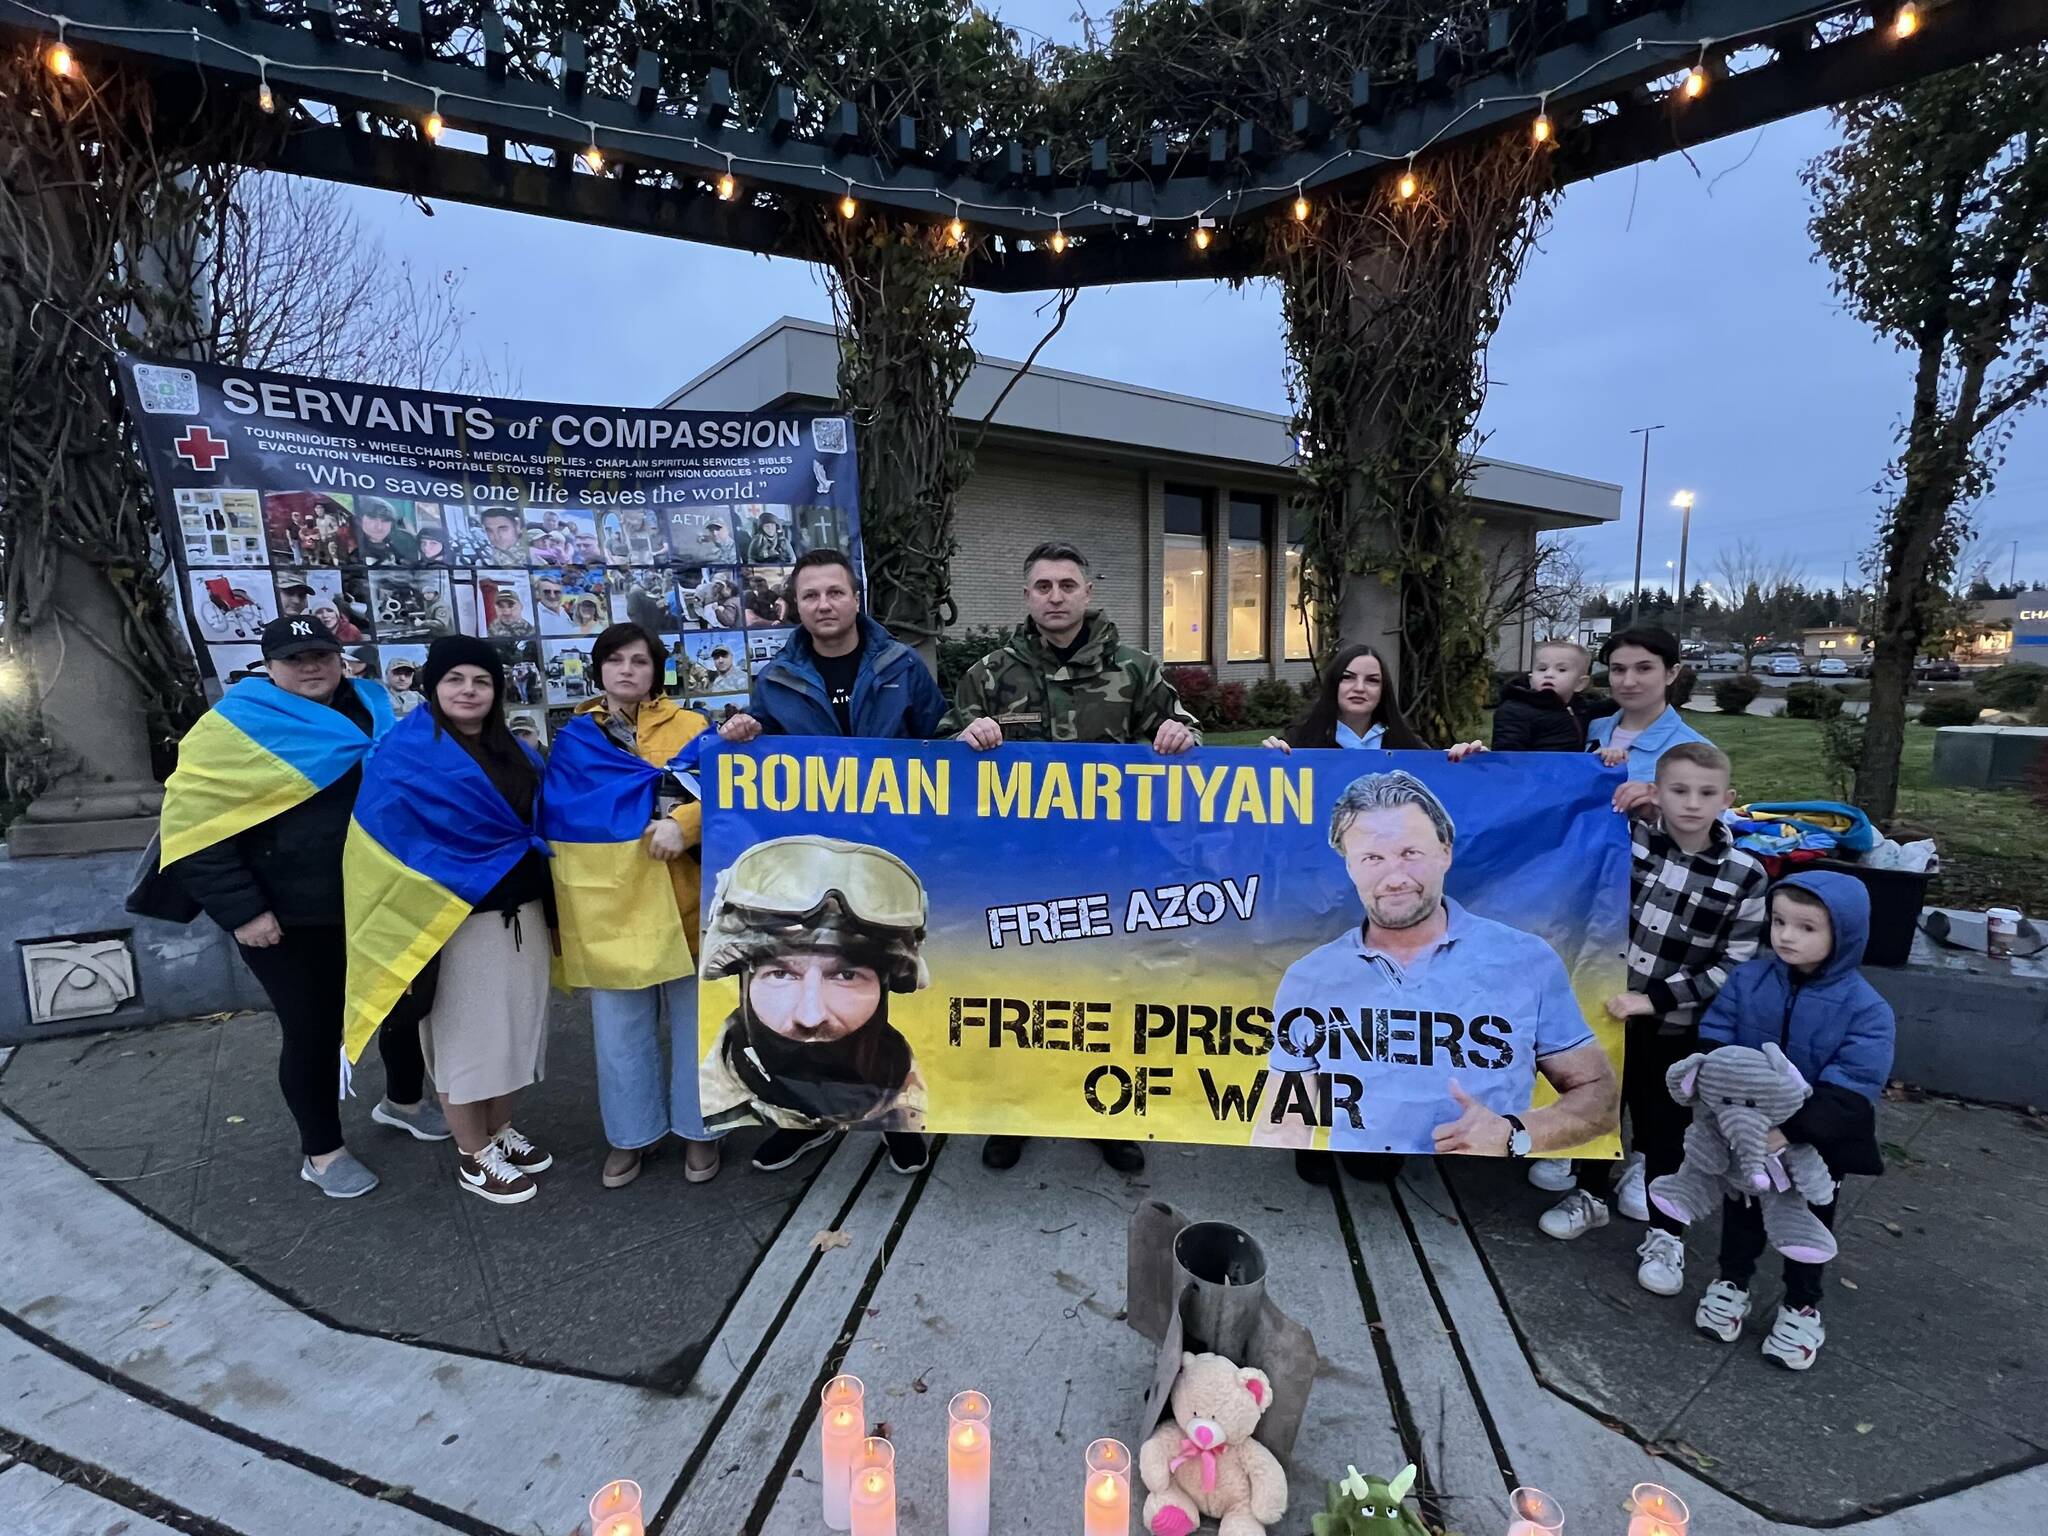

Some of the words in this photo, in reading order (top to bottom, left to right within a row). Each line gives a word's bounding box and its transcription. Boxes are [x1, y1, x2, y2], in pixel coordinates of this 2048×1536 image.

[222, 378, 495, 440] SERVANTS
[508, 416, 543, 440] of
[551, 415, 800, 448] COMPASSION
[243, 426, 357, 449] TOUNRNIQUETS
[368, 440, 463, 459] WHEELCHAIRS
[473, 451, 527, 463] MEDICAL
[530, 455, 586, 467] SUPPLIES
[595, 458, 649, 468] CHAPLAIN
[651, 459, 700, 468] SPIRITUAL
[702, 458, 750, 467] SERVICES
[758, 456, 793, 466] BIBLES
[258, 440, 349, 461] EVACUATION
[352, 452, 418, 467] VEHICLES
[428, 460, 494, 473] PORTABLE
[497, 464, 544, 476] STOVES
[554, 468, 627, 479] STRETCHERS
[635, 470, 665, 479] NIGHT
[668, 469, 700, 478] VISION
[703, 468, 751, 478] GOGGLES
[760, 466, 787, 475] FOOD
[385, 477, 464, 499] saves
[473, 483, 520, 501] one
[528, 481, 569, 504] life
[579, 489, 646, 505] saves
[652, 485, 686, 504] the
[717, 753, 950, 816] ROMAN
[977, 761, 1313, 825] MARTIYAN
[987, 893, 1112, 948] FREE
[1125, 874, 1261, 933] AZOV
[949, 996, 1112, 1053] FREE
[1134, 1004, 1514, 1069] PRISONERS
[1083, 1064, 1172, 1118] OF
[1197, 1066, 1366, 1130] WAR
